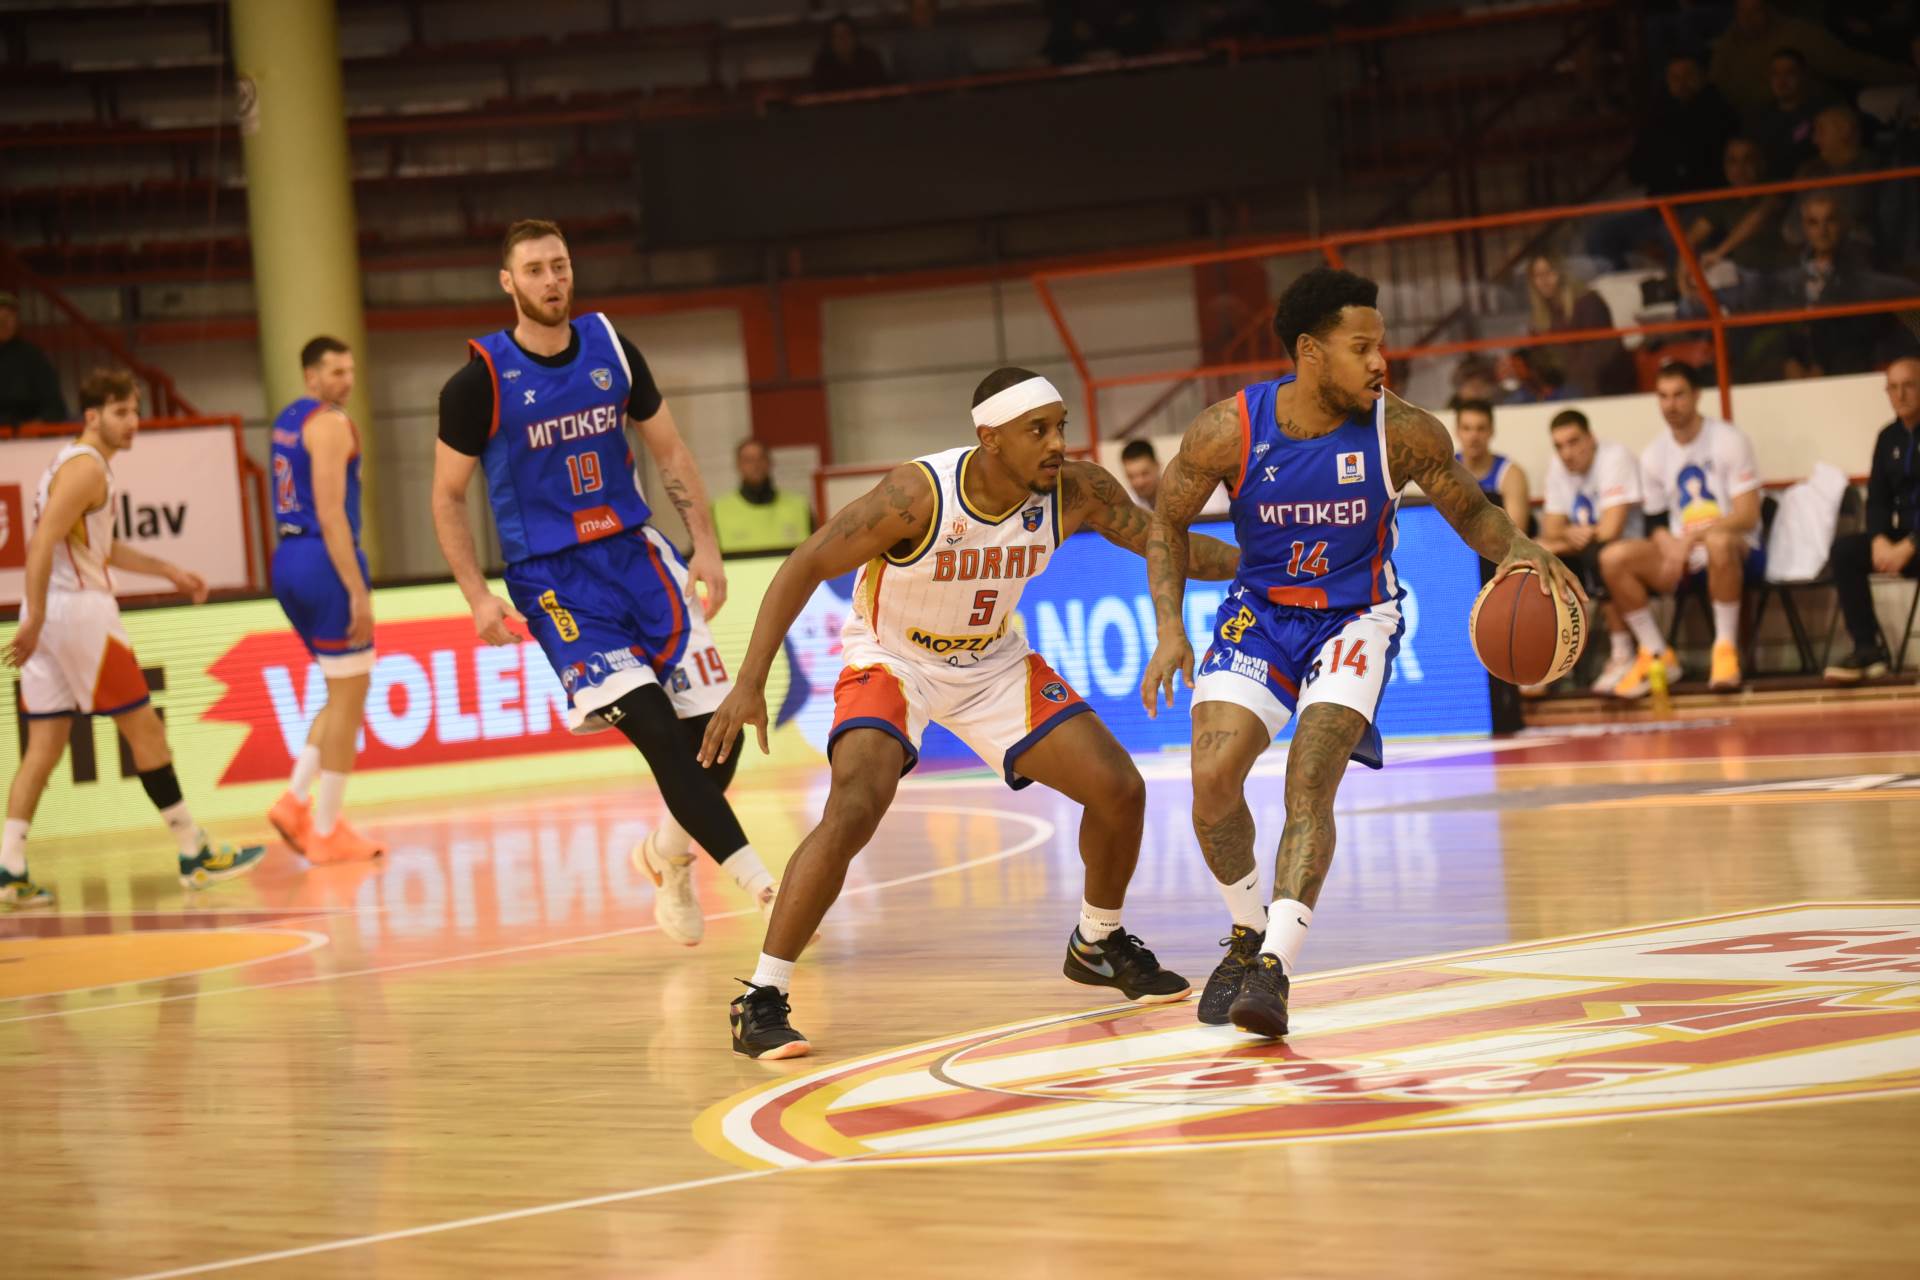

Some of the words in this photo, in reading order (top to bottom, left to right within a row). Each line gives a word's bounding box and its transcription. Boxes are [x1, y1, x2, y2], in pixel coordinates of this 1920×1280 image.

[527, 405, 617, 449] ИГОКЕА
[566, 451, 603, 496] 19
[112, 494, 187, 540] lav
[1259, 498, 1367, 526] ИГОКЕА
[932, 545, 1047, 582] BORAC
[1287, 541, 1330, 577] 14
[968, 590, 999, 626] 5
[692, 645, 728, 687] 19
[1230, 660, 1269, 685] BANKA
[1233, 649, 1269, 673] NOVA
[1329, 637, 1368, 678] 14
